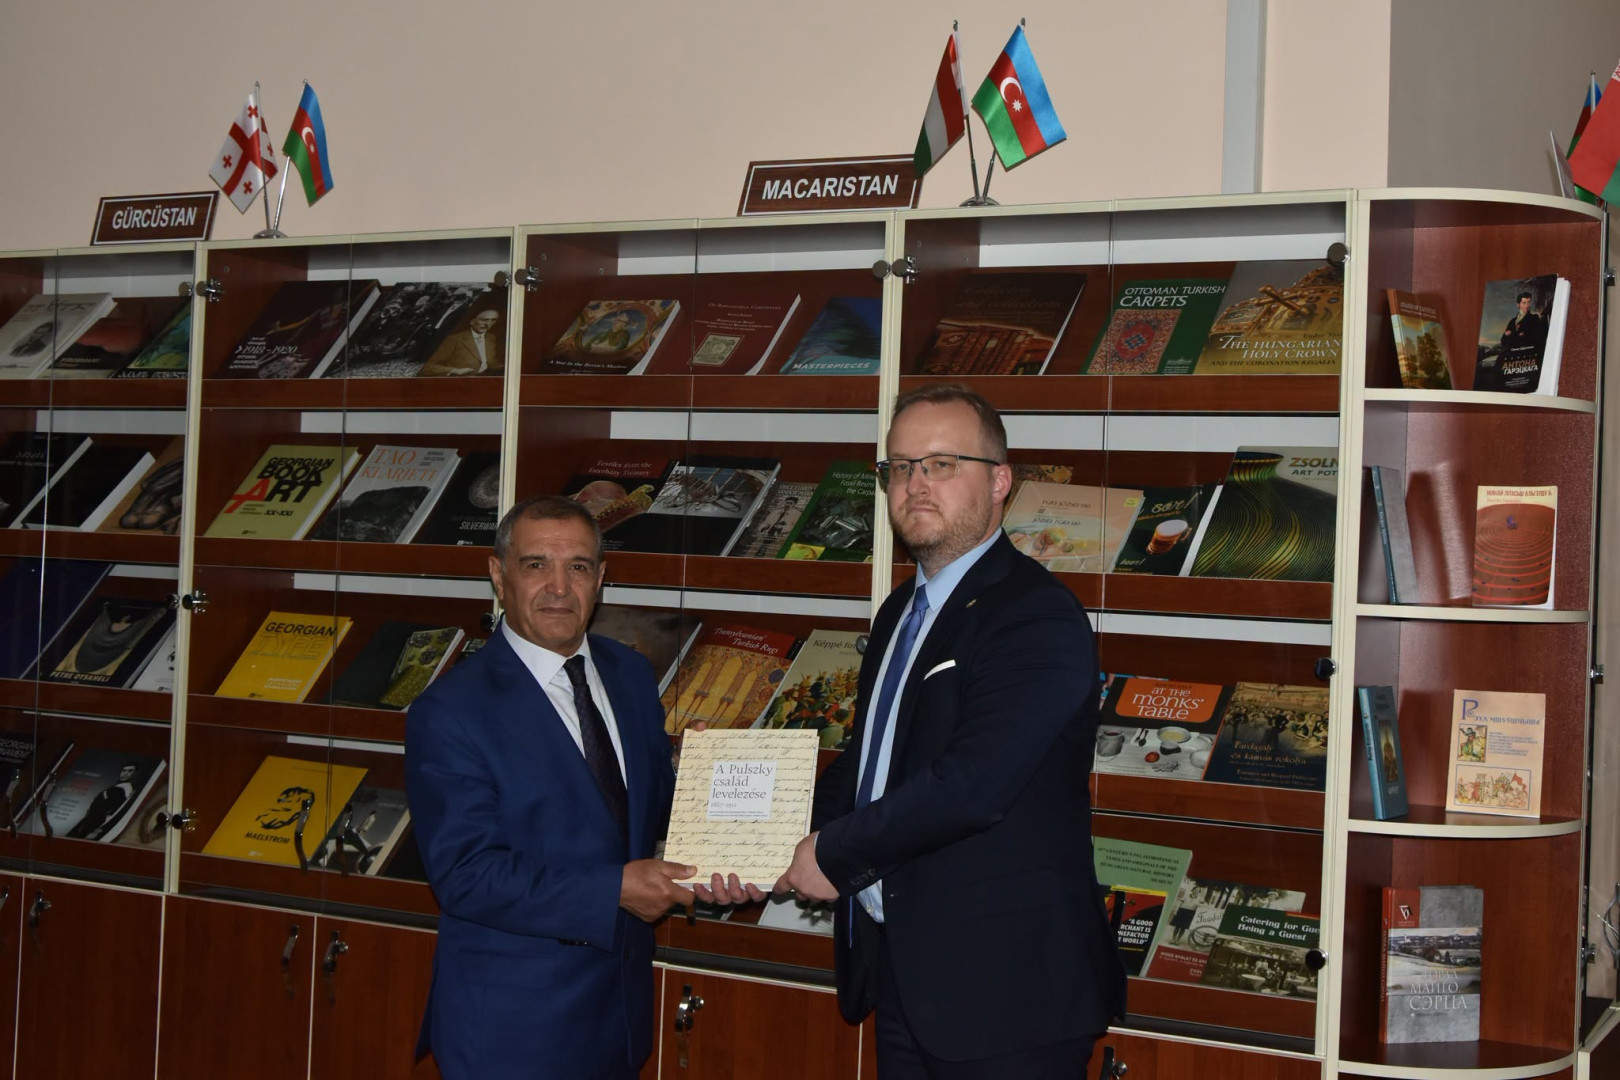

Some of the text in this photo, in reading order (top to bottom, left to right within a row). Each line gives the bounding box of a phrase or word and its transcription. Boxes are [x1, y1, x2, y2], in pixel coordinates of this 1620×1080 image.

[762, 174, 899, 200] MACARISTAN
[112, 205, 197, 229] GÜRCÜSTAN
[1125, 285, 1226, 295] OTTOMAN TURKISH
[1120, 295, 1188, 307] CARPETS
[1254, 339, 1341, 349] HUNGARIAN
[1243, 348, 1338, 359] HOLY CROWN
[793, 362, 871, 370] MASTERPIECES
[267, 457, 335, 468] GEORGIAN
[373, 449, 416, 466] TAO
[257, 463, 322, 486] BOOK
[360, 466, 438, 482] KLARJETI
[224, 478, 319, 514] ART
[265, 622, 337, 636] GEORGIAN
[732, 638, 779, 655] Turkish Rugs
[715, 763, 773, 776] A Pulszky
[713, 775, 749, 787] család
[712, 787, 767, 799] levelezése
[244, 832, 290, 844] MAELSTROM
[1136, 919, 1153, 927] GOOD
[1240, 915, 1280, 929] Catering
[1284, 921, 1298, 930] for
[1238, 923, 1265, 935] Being
[1278, 930, 1306, 941] Guest
